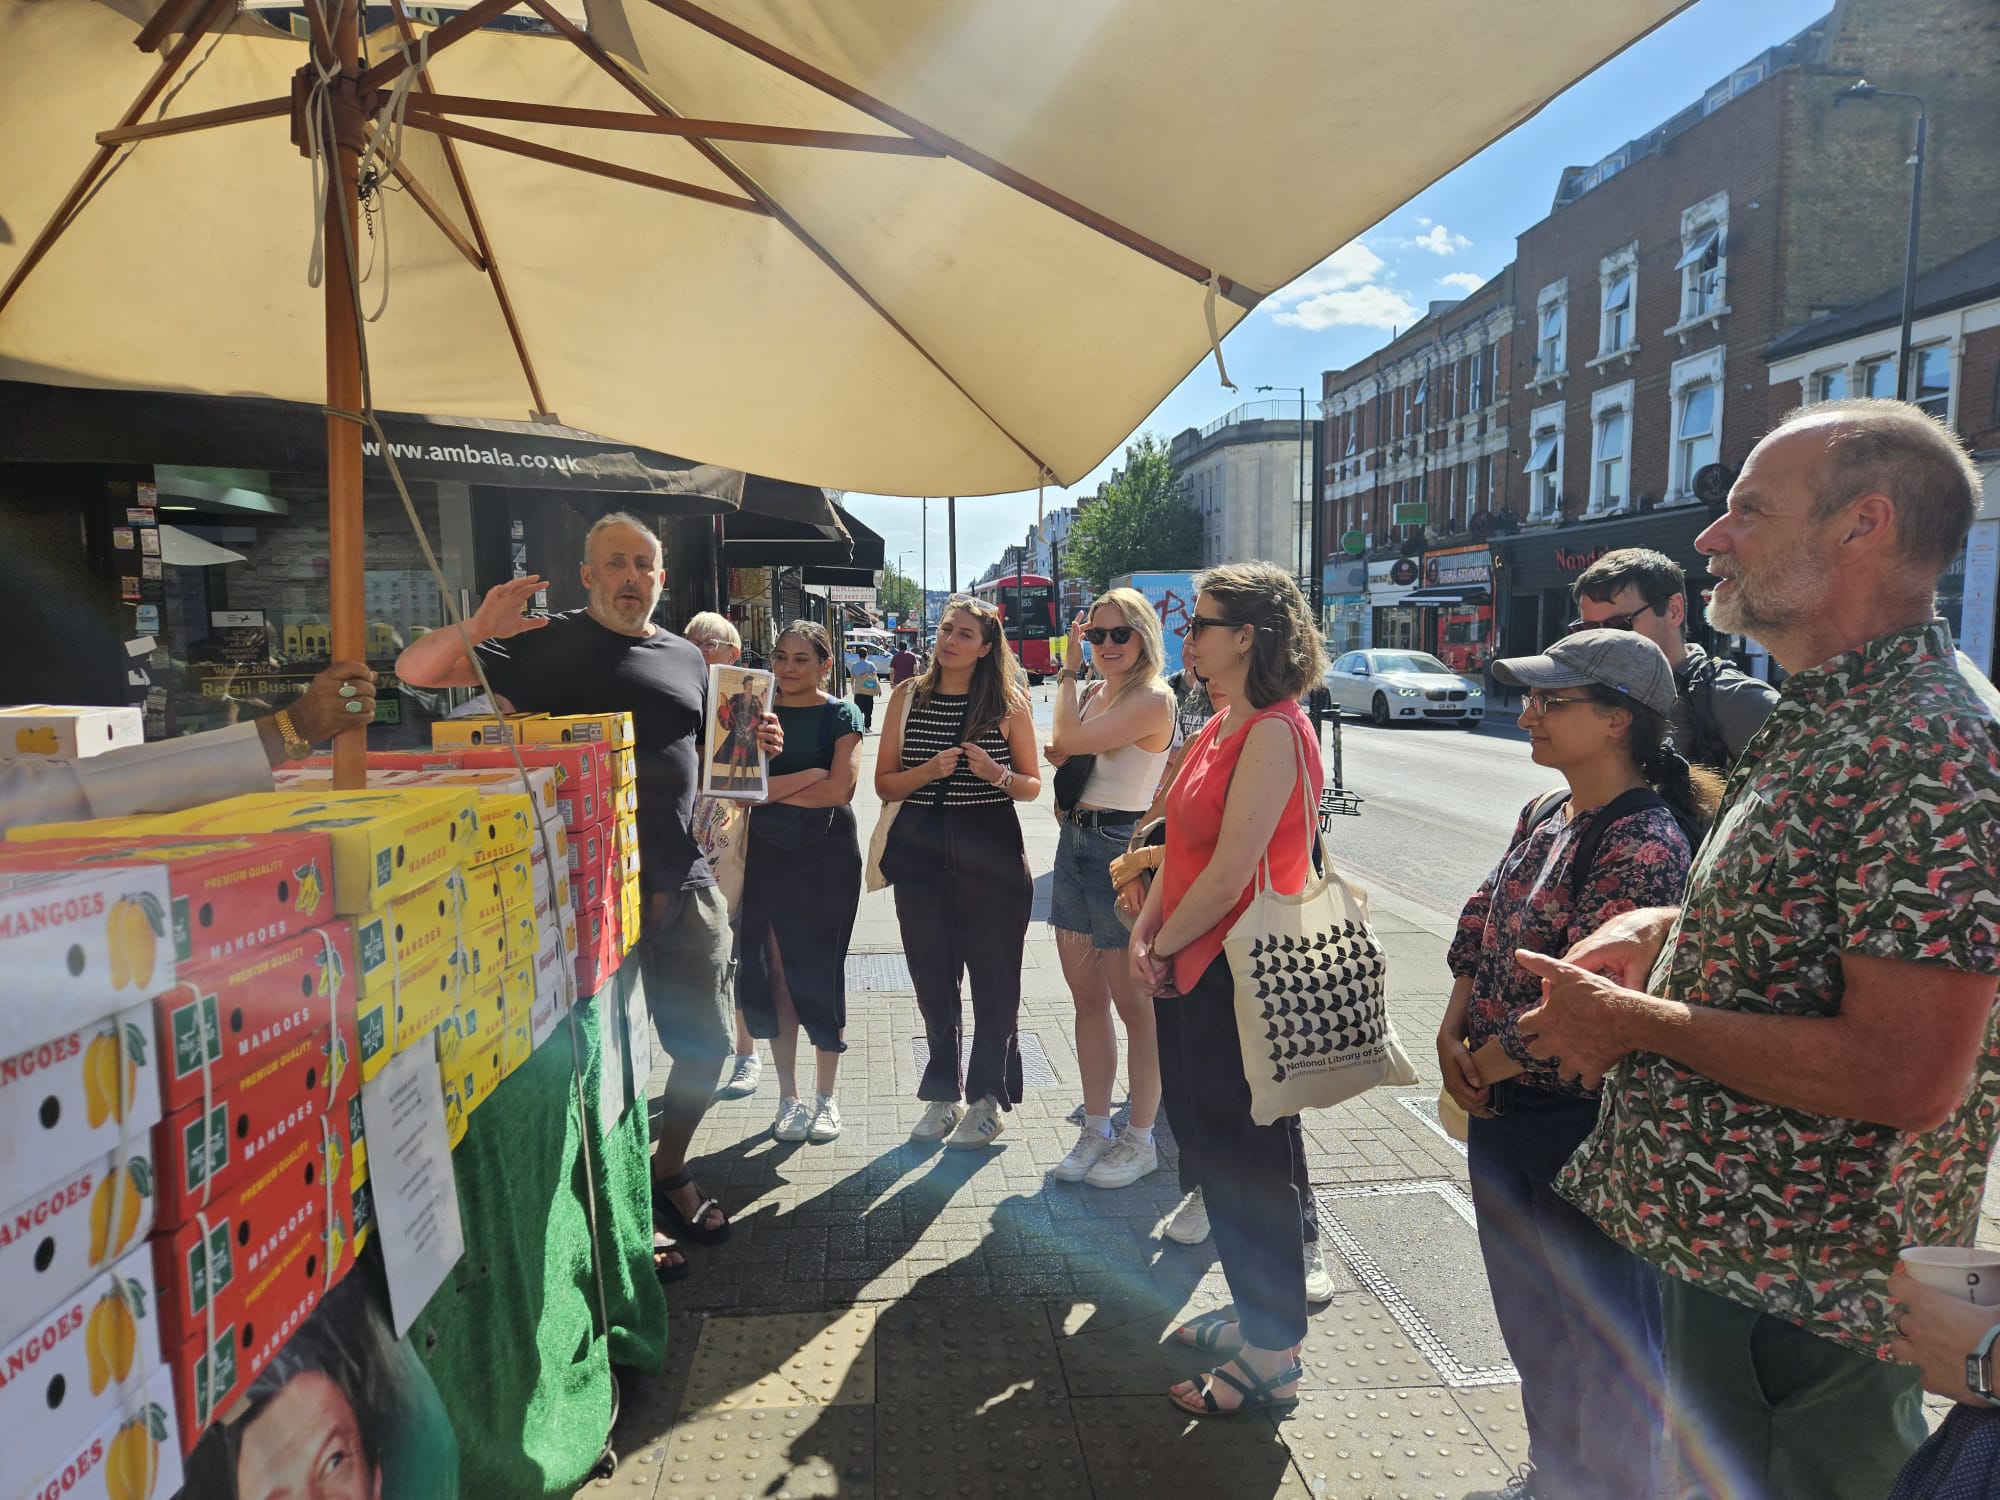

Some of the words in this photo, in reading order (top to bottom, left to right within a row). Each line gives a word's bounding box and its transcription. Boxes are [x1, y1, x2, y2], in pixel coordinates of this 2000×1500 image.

[202, 681, 250, 696] Retail
[258, 680, 310, 694] Busin
[213, 666, 248, 675] Winner
[252, 666, 272, 674] 2014
[204, 868, 248, 891] PREMIUM
[249, 860, 283, 878] QUALITY
[210, 920, 286, 960] MANGOES
[228, 958, 270, 988] PREMIUM
[270, 946, 304, 970] QUALITY
[238, 1007, 310, 1056] MANGOES
[0, 1032, 81, 1088] NGOES
[240, 1062, 279, 1092] PREMIUM
[280, 1040, 312, 1066] QUALITY
[1287, 1058, 1326, 1072] National
[1328, 1053, 1360, 1064] Library
[1363, 1049, 1372, 1057] of
[244, 1100, 312, 1160] MANGOES
[278, 1140, 309, 1173] QUALITY
[0, 1174, 92, 1248] ANGOES
[248, 1200, 314, 1272] MANGOES
[252, 1291, 314, 1373] MANGOES
